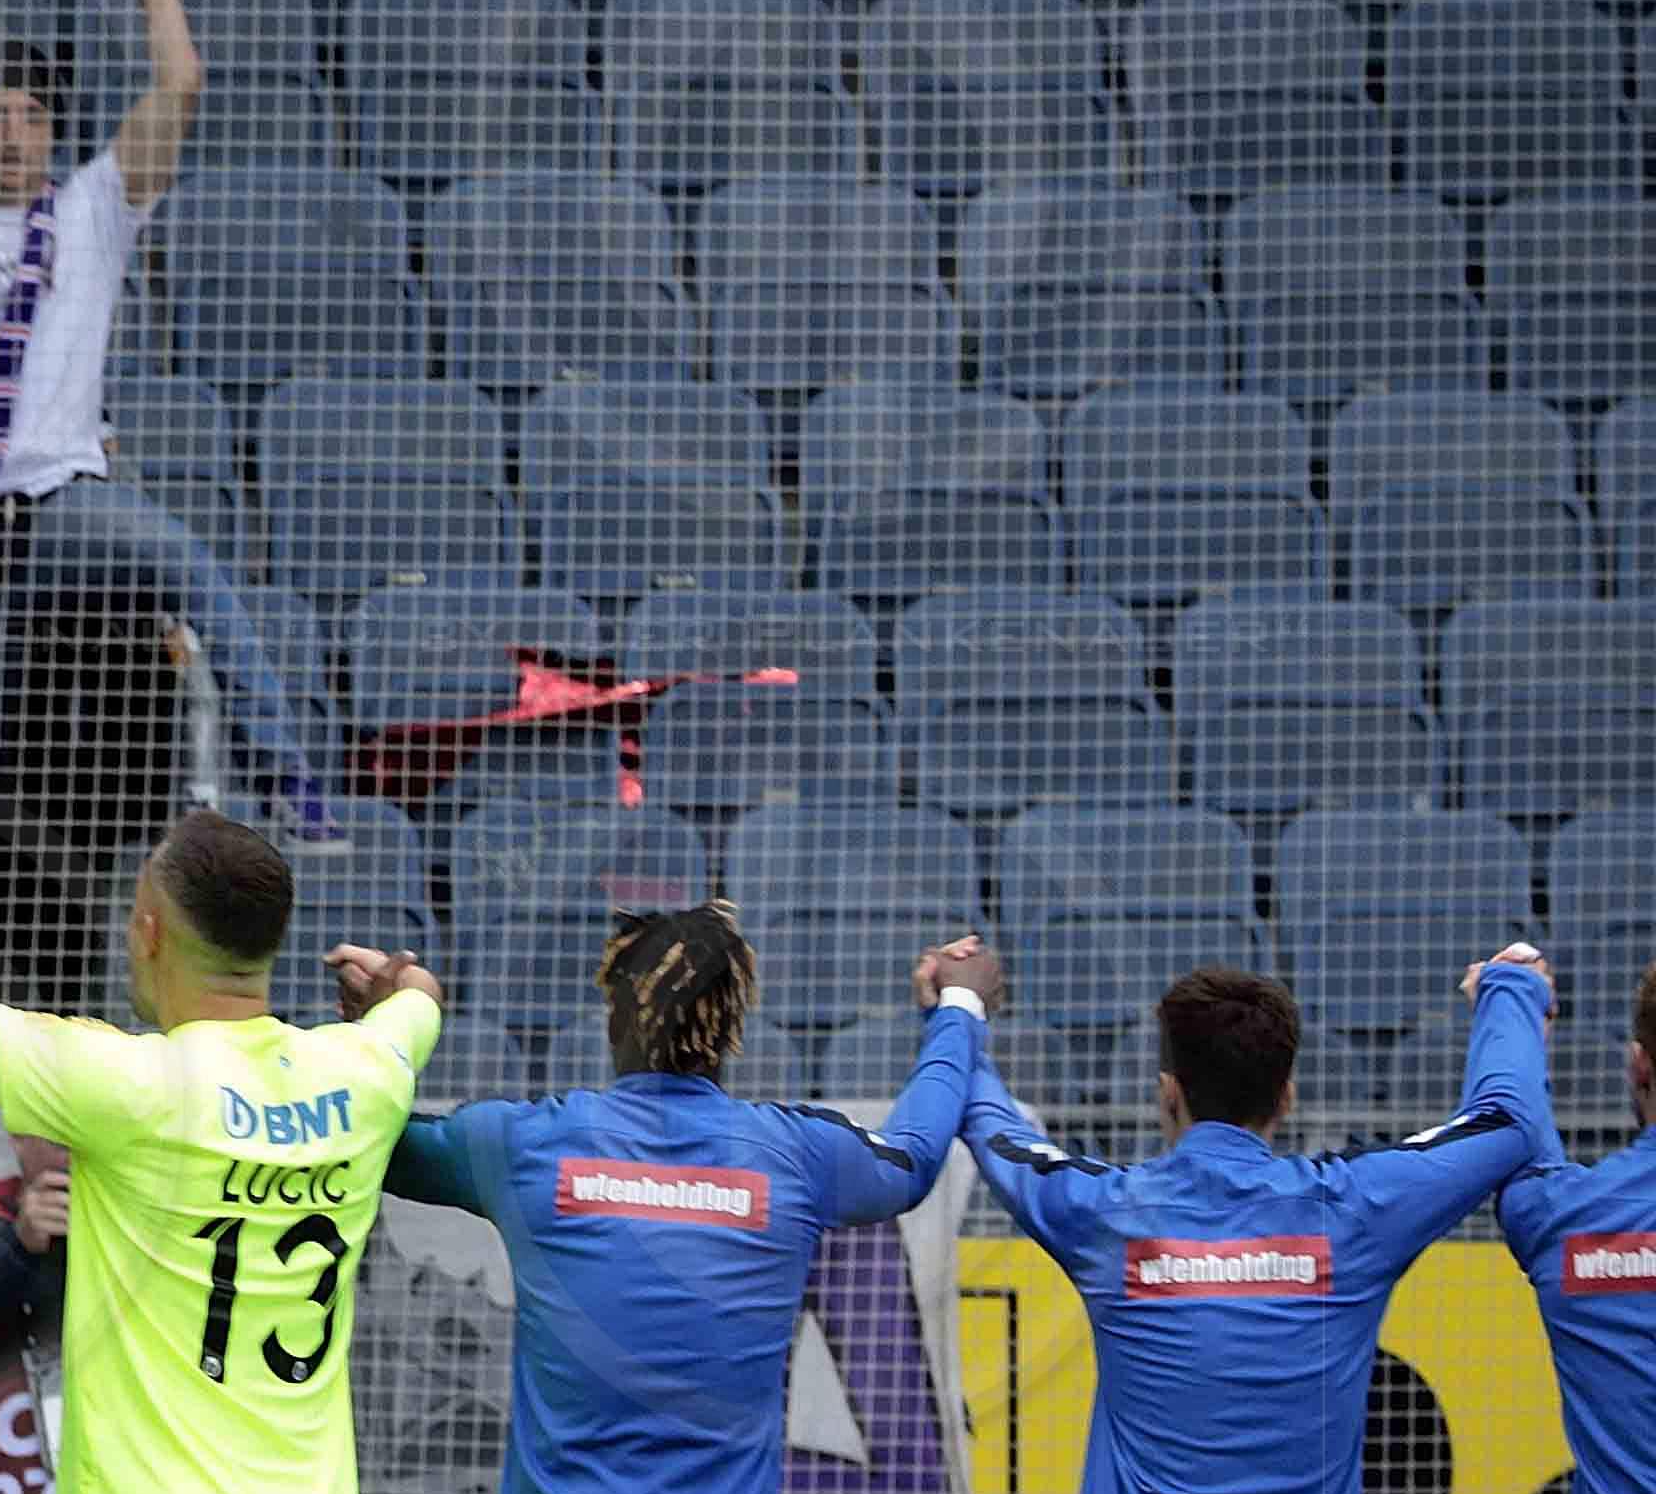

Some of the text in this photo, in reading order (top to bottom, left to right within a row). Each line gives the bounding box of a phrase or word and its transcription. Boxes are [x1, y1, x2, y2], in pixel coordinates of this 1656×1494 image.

[570, 1172, 753, 1219] wienholding
[1138, 1251, 1317, 1284] wienholding
[192, 1214, 350, 1386] 13
